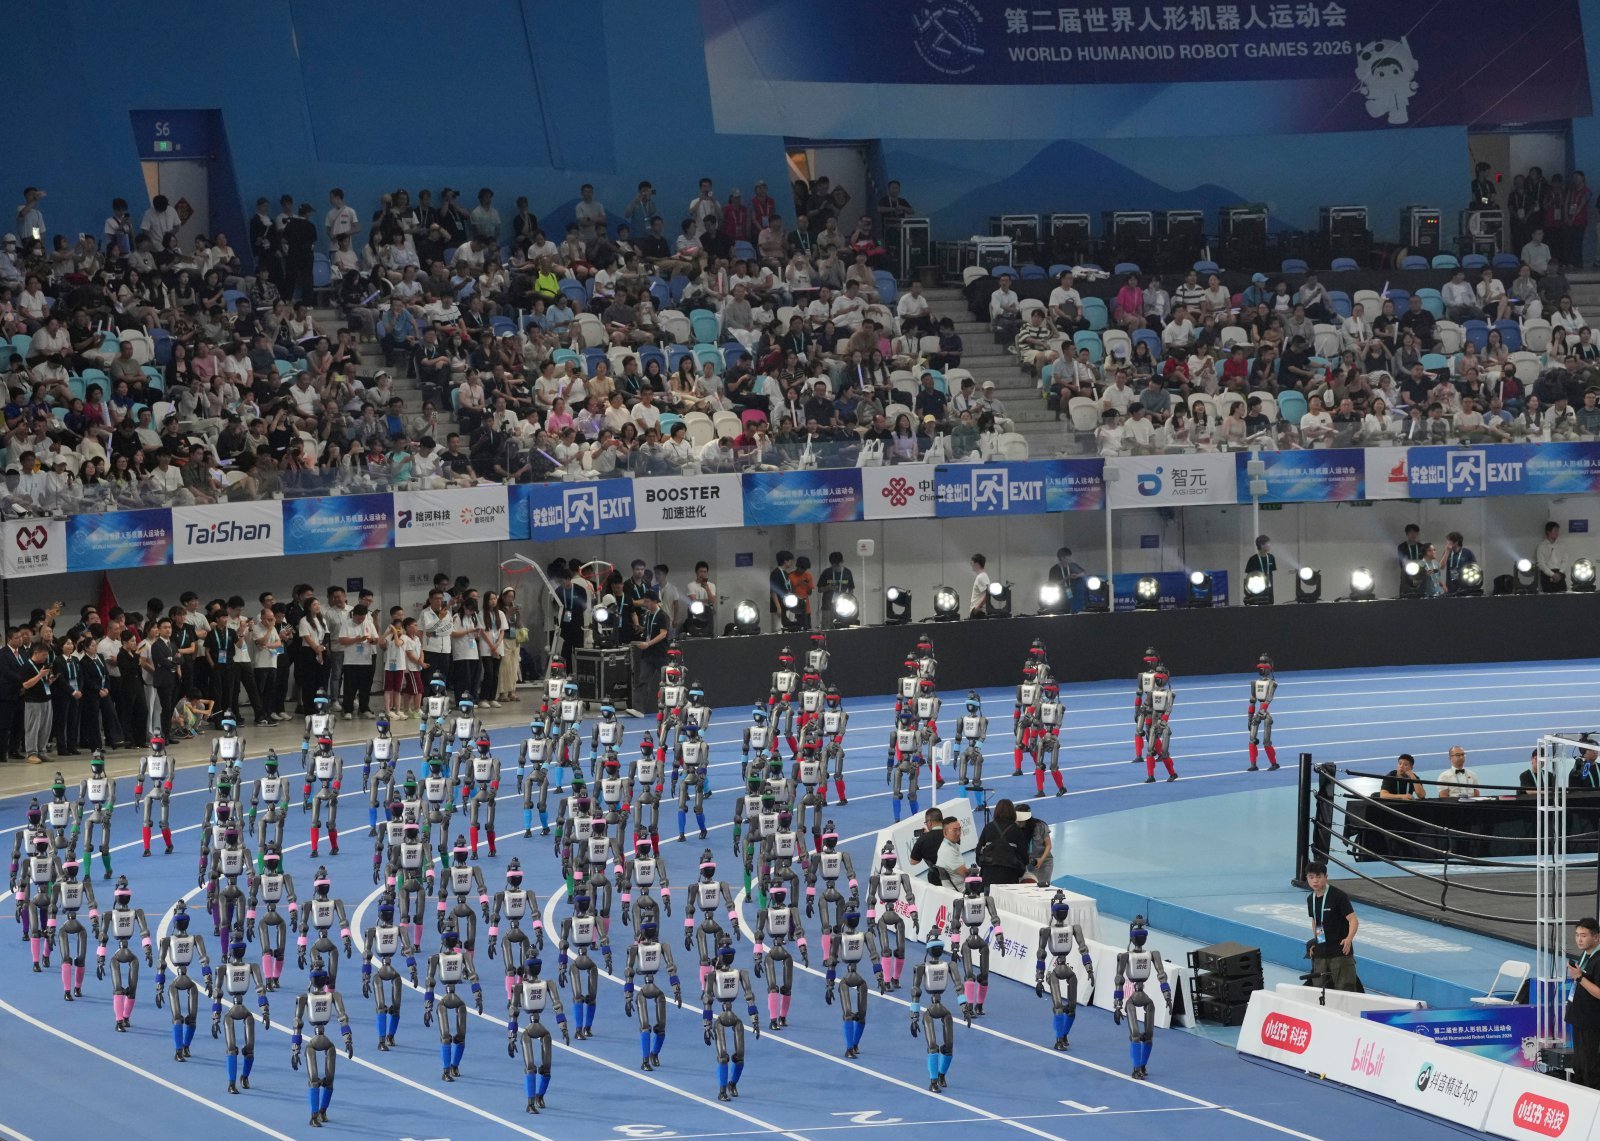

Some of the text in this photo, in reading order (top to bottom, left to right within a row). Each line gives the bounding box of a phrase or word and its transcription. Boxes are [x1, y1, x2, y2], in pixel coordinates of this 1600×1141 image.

[1004, 2, 1347, 34] 第二届世界人形机器人运动会
[1008, 41, 1351, 62] WORLD HUMANOID ROBOT GAMES 2026
[155, 122, 170, 136] S6
[1171, 468, 1207, 487] 智元
[1411, 465, 1446, 484] 安全出口
[1487, 462, 1523, 482] EXIT
[646, 485, 720, 502] BOOSTER
[919, 480, 935, 492] 中
[1009, 481, 1043, 500] EXIT
[533, 505, 563, 527] 安全出口
[600, 497, 631, 520] EXIT
[662, 505, 706, 520] 加速进化
[185, 521, 271, 545] TaiShan
[1265, 1020, 1308, 1047] 小红书 科技
[830, 1110, 903, 1124] 2
[1518, 1100, 1565, 1131] 小红书 科技
[612, 1124, 678, 1137] 3
